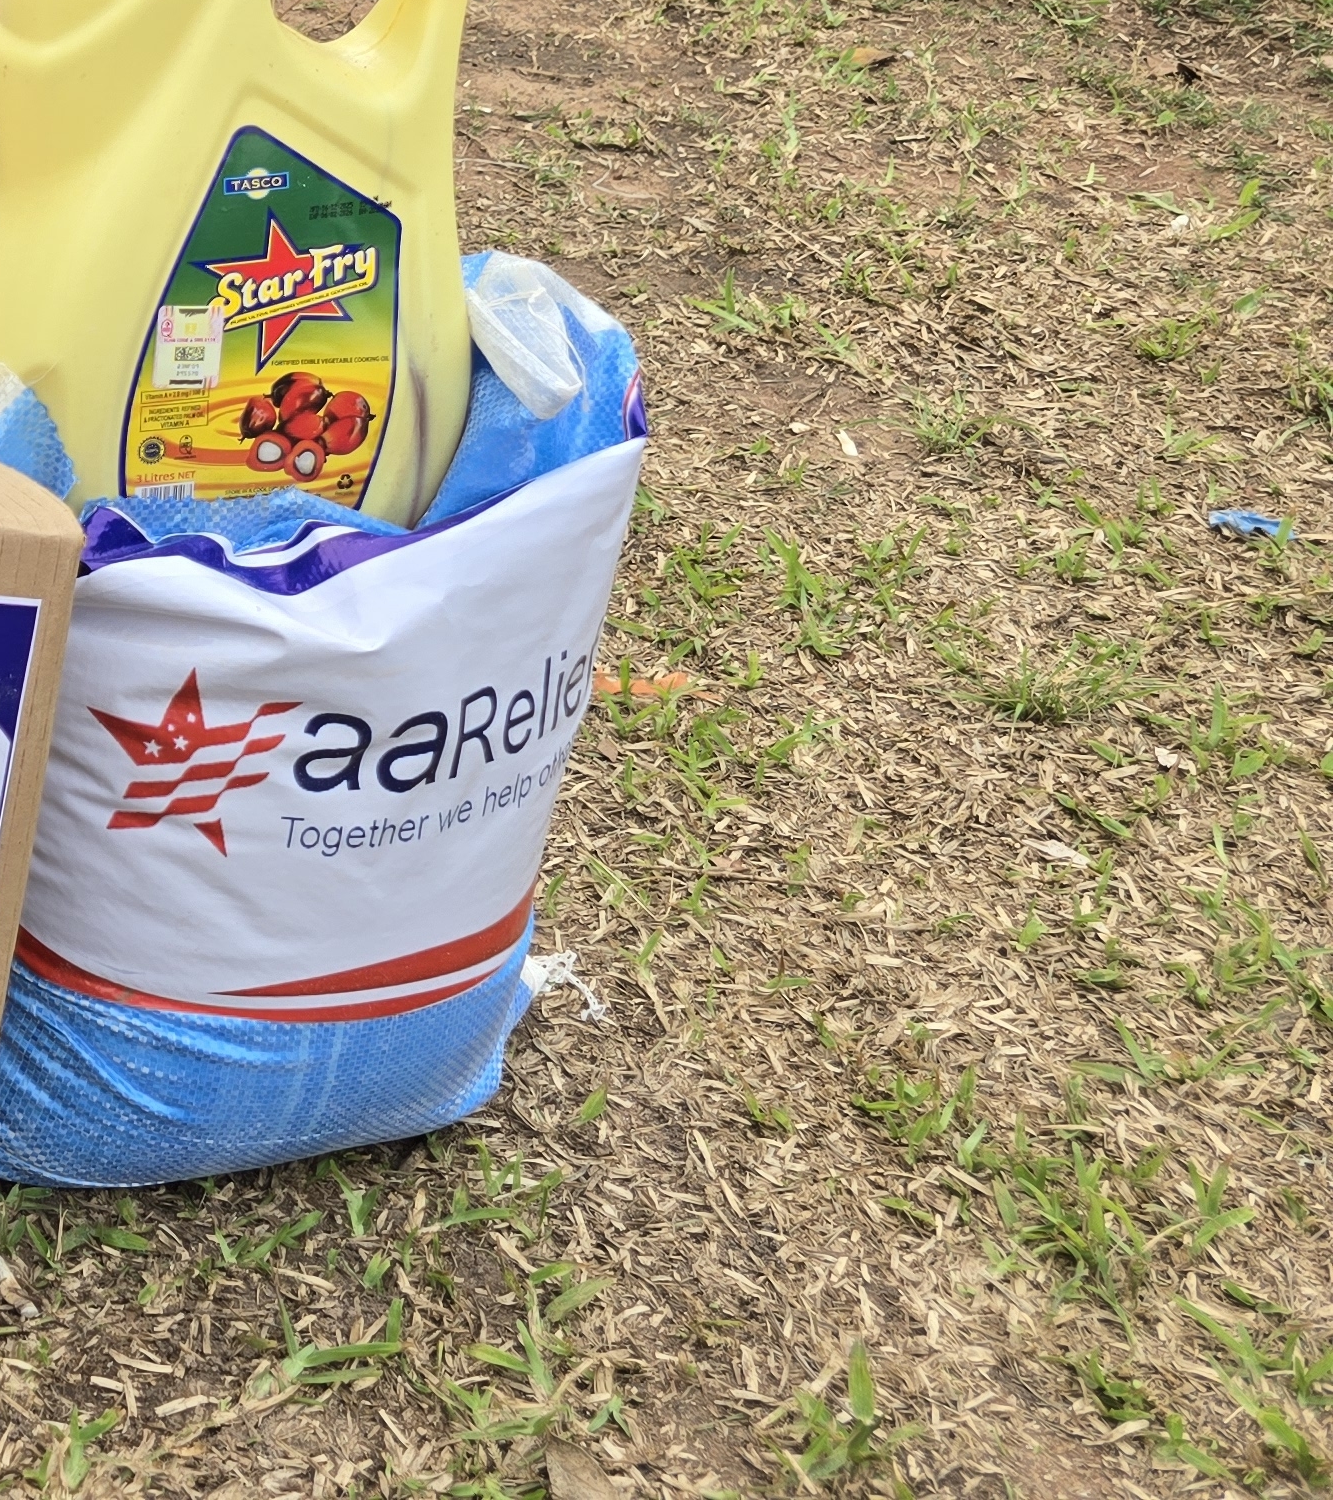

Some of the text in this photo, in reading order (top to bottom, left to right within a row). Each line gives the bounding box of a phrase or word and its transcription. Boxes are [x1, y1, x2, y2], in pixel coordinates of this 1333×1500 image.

[230, 176, 282, 191] TASCO
[136, 470, 196, 483] 3 Litres NET
[280, 814, 430, 858] Together
[437, 796, 474, 833] we
[481, 776, 532, 818] help
